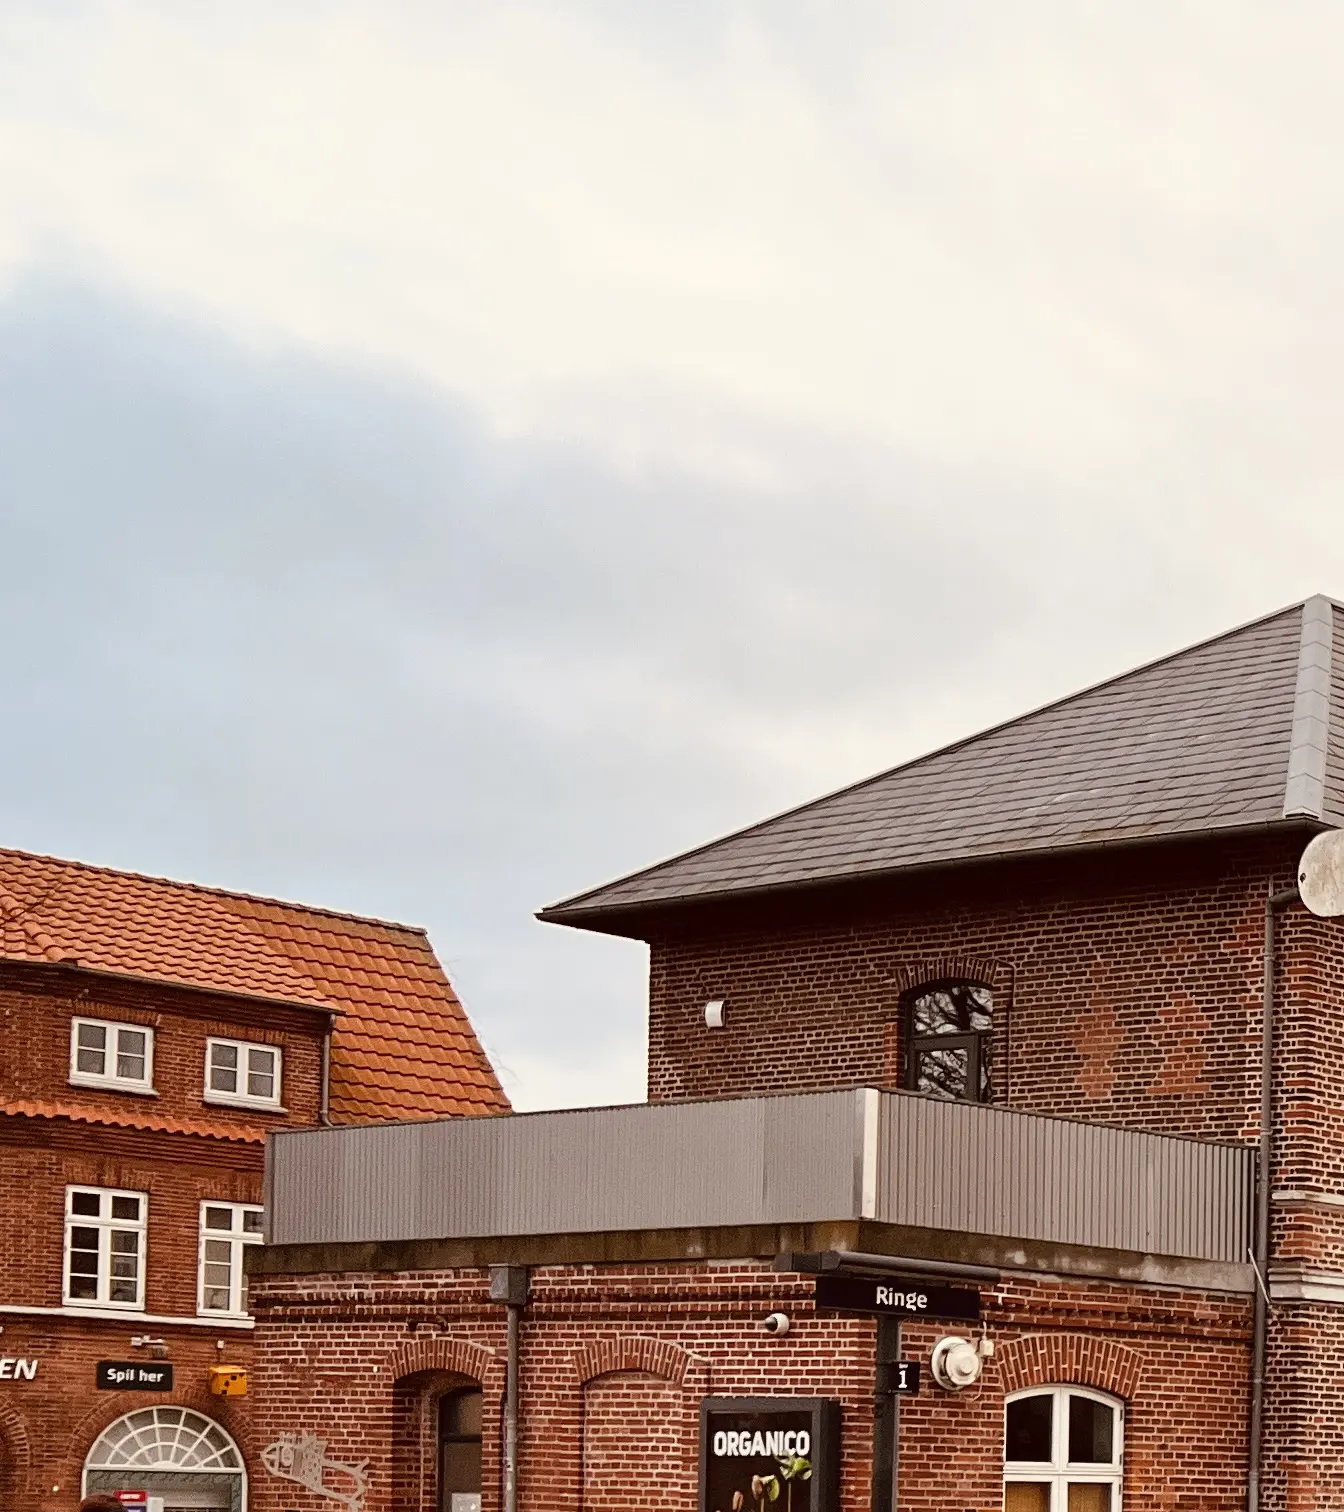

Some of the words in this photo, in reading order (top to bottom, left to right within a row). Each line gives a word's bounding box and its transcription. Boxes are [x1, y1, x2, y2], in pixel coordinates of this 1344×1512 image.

[875, 1285, 928, 1311] Ringe
[0, 1358, 38, 1380] EN
[106, 1368, 134, 1383] Spil
[138, 1369, 165, 1382] her
[898, 1369, 908, 1389] 1
[713, 1430, 811, 1457] ORGANICO
